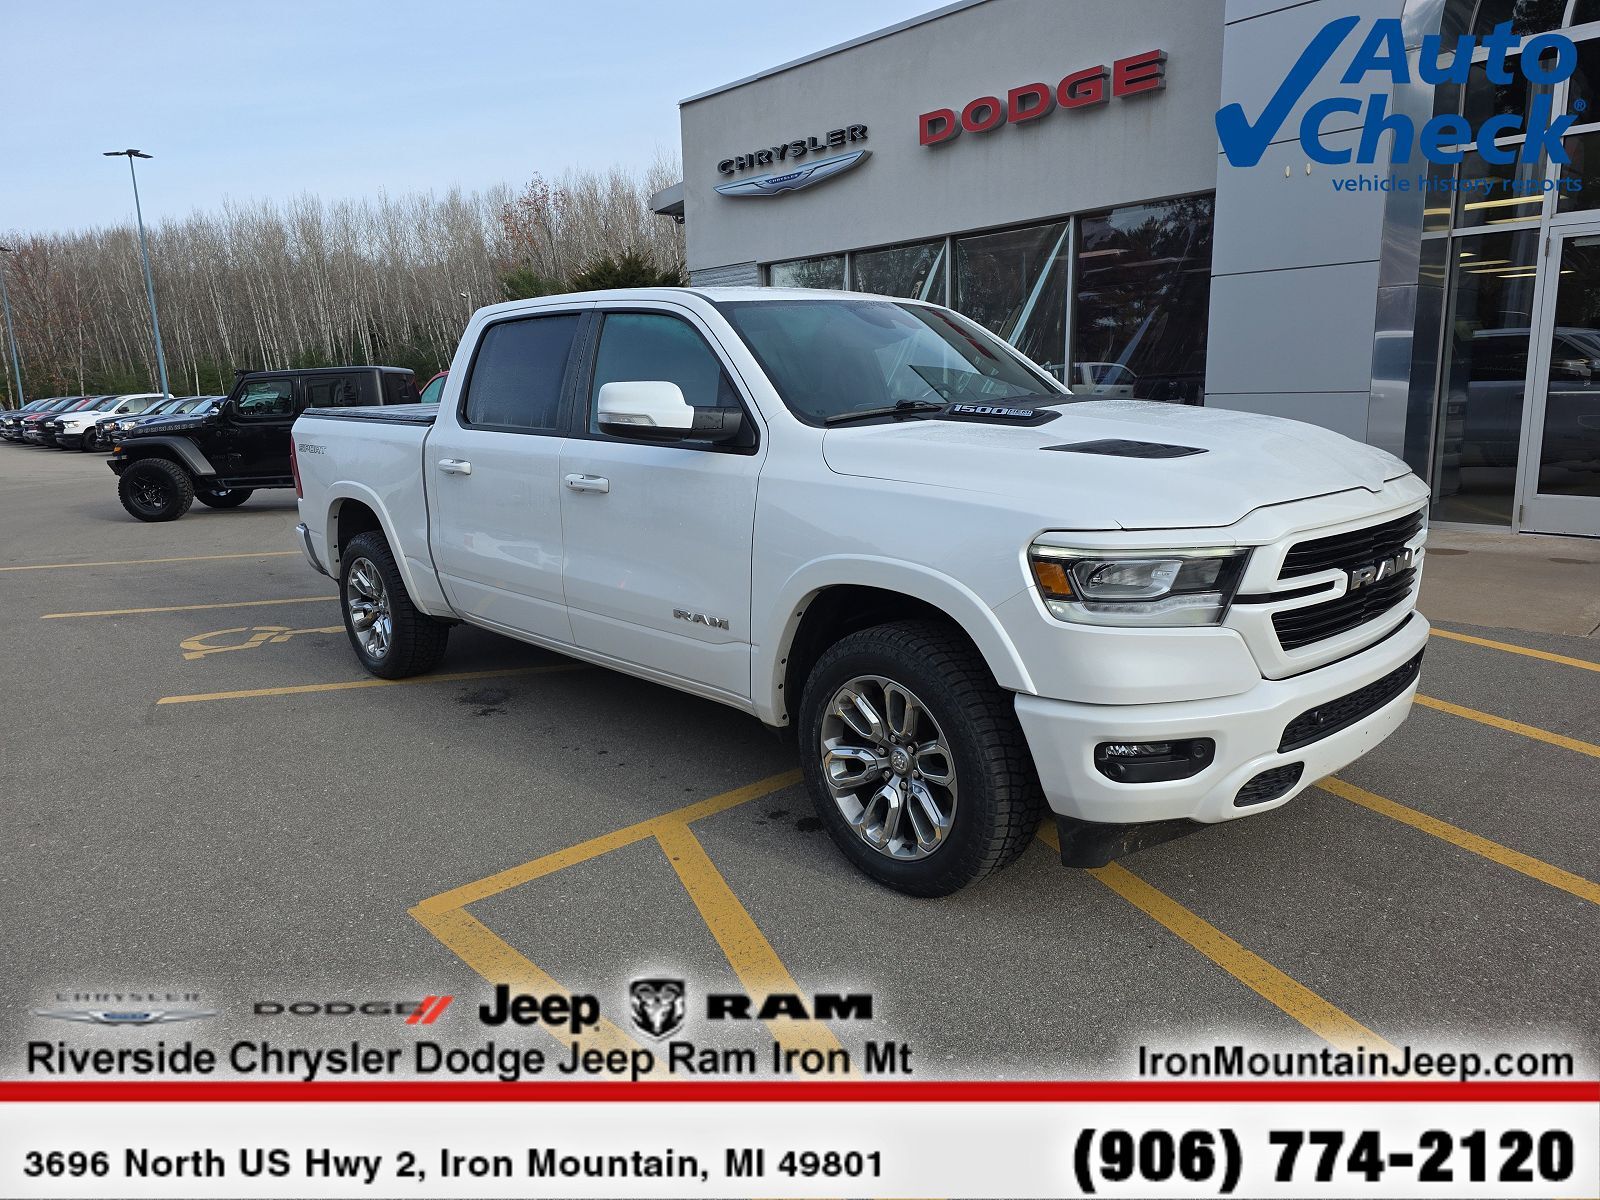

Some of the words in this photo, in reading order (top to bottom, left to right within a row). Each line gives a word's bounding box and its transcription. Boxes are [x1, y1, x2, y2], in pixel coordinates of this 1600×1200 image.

[919, 48, 1168, 147] DODGE
[717, 123, 868, 176] CHRYSLER
[953, 404, 1009, 415] 1500
[298, 443, 327, 455] SPORT
[1350, 548, 1413, 591] RAM
[672, 607, 729, 630] RAM
